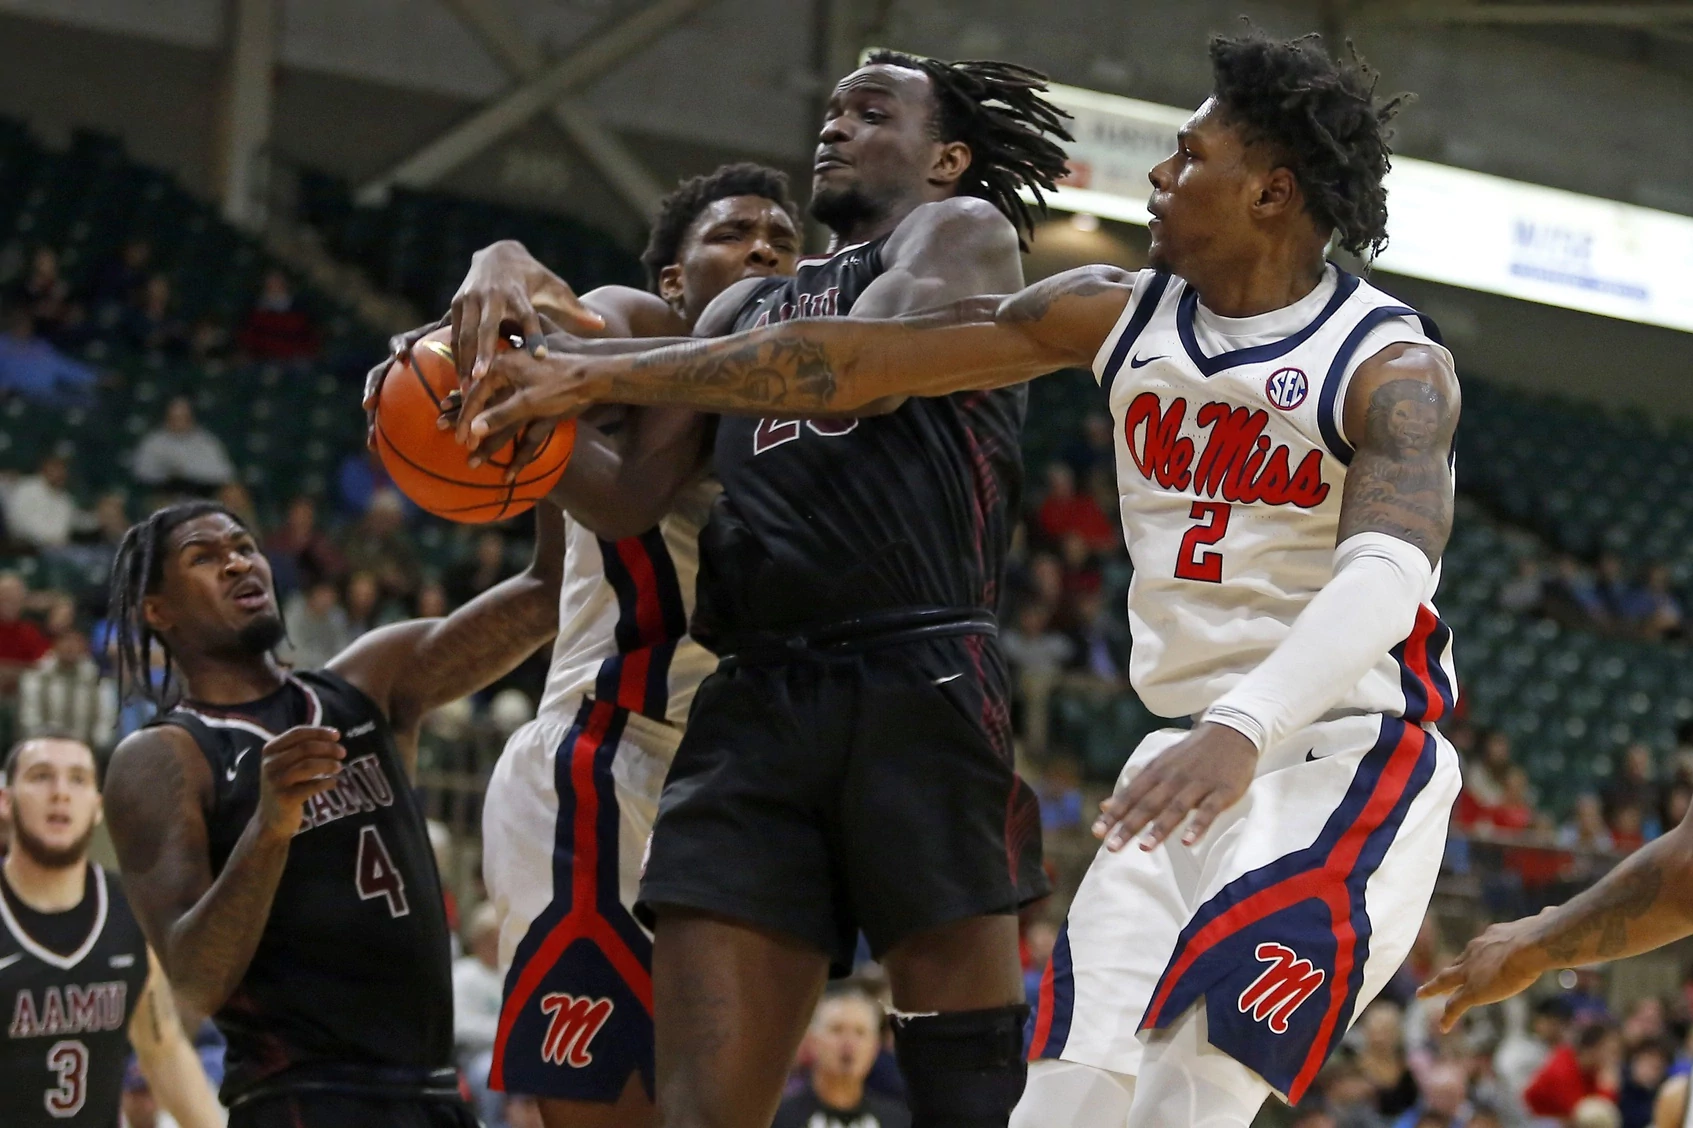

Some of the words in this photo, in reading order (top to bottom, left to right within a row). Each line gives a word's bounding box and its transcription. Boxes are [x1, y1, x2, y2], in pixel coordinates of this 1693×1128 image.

[1269, 370, 1306, 408] SEC
[1125, 392, 1194, 491] Ole
[1194, 401, 1330, 508] Miss
[1174, 501, 1231, 583] 2
[292, 754, 394, 837] AMU
[356, 824, 410, 917] 4
[9, 980, 127, 1038] AAMU
[1238, 943, 1325, 1034] M
[541, 993, 613, 1068] M
[45, 1040, 89, 1117] 3
